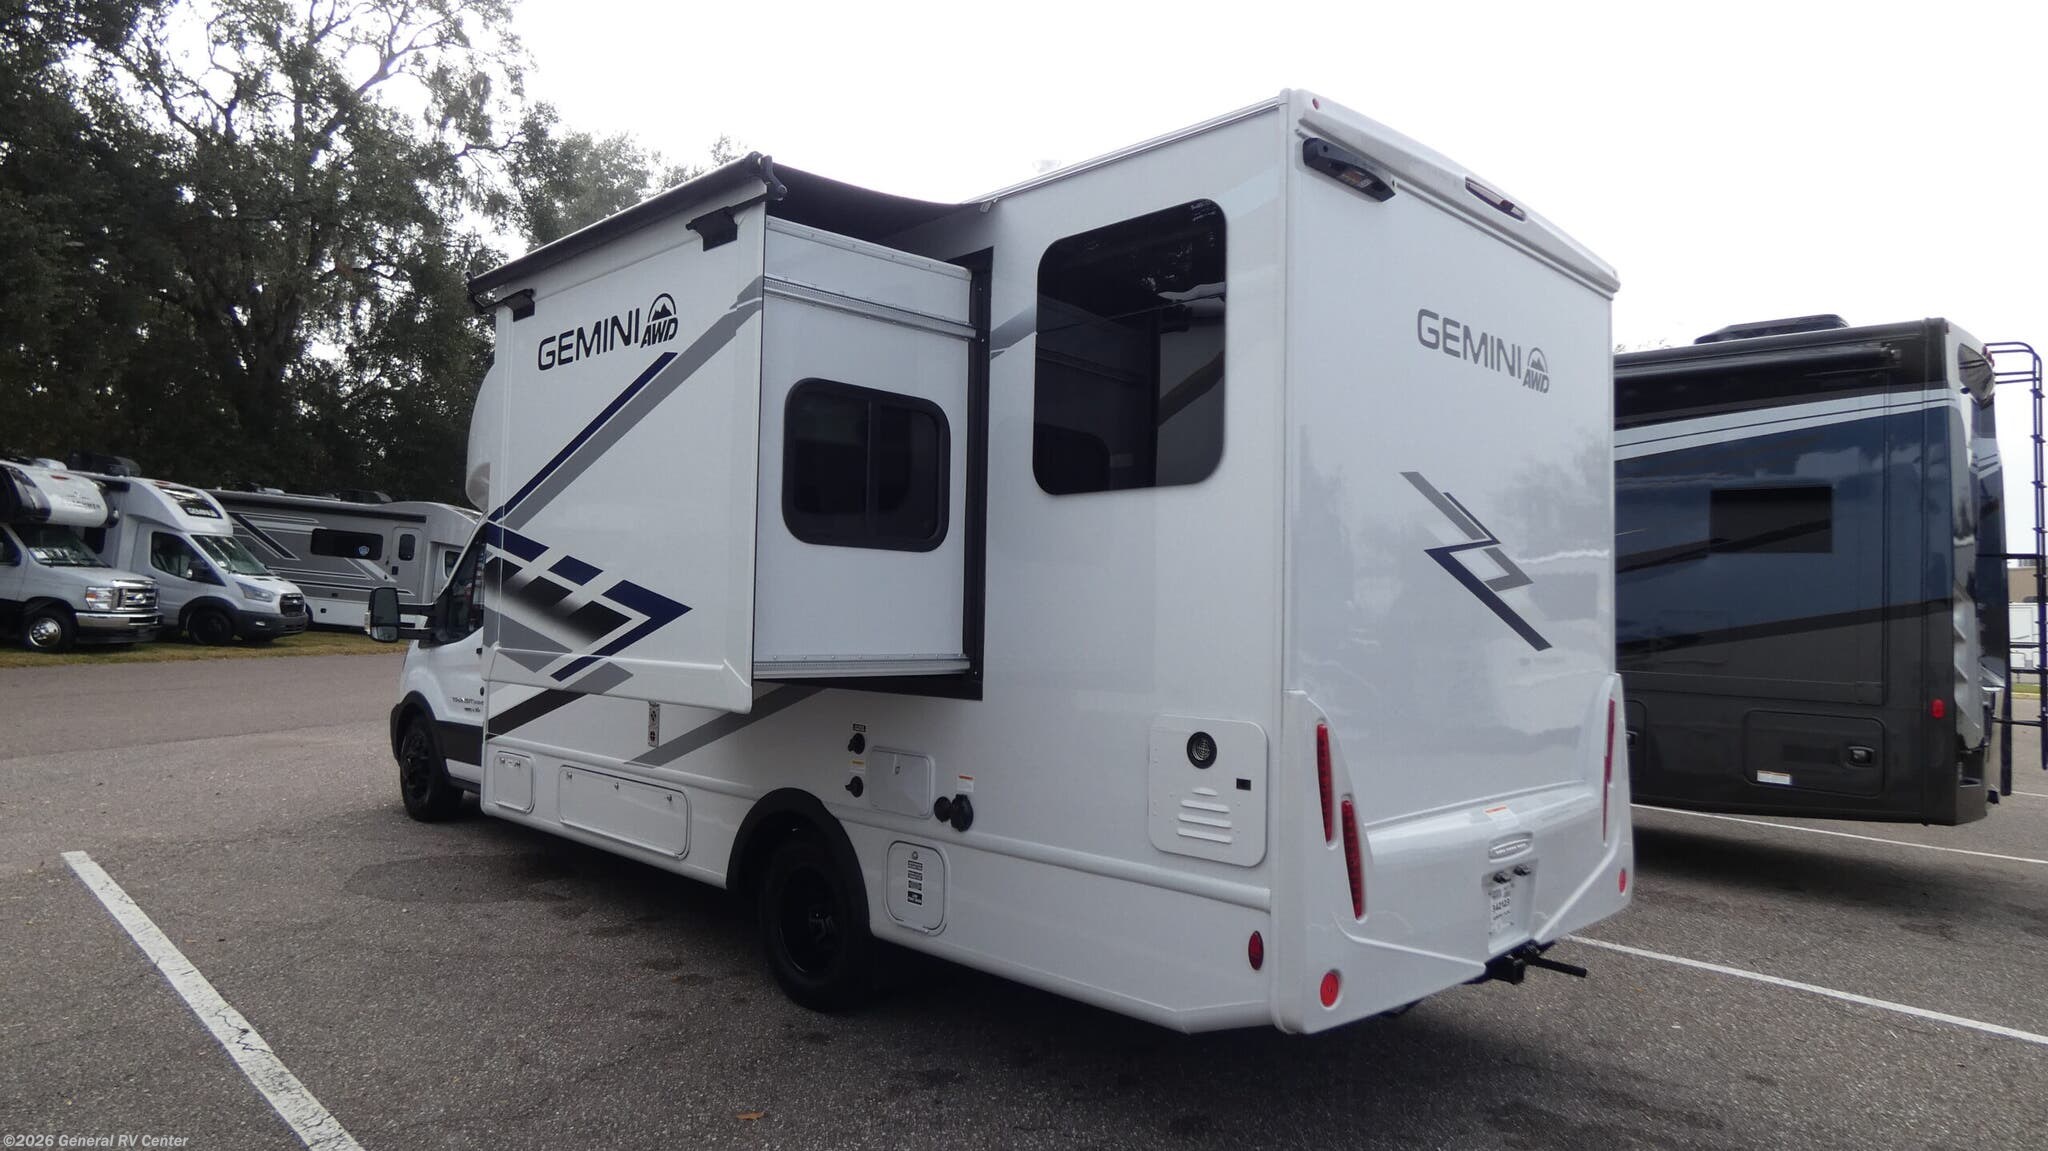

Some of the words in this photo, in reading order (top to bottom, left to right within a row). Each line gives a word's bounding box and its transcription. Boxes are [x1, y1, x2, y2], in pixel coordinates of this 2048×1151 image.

[538, 308, 640, 371] GEMINI
[640, 317, 679, 349] AWD
[1417, 308, 1521, 379] GEMINI
[1522, 368, 1550, 394] AWD
